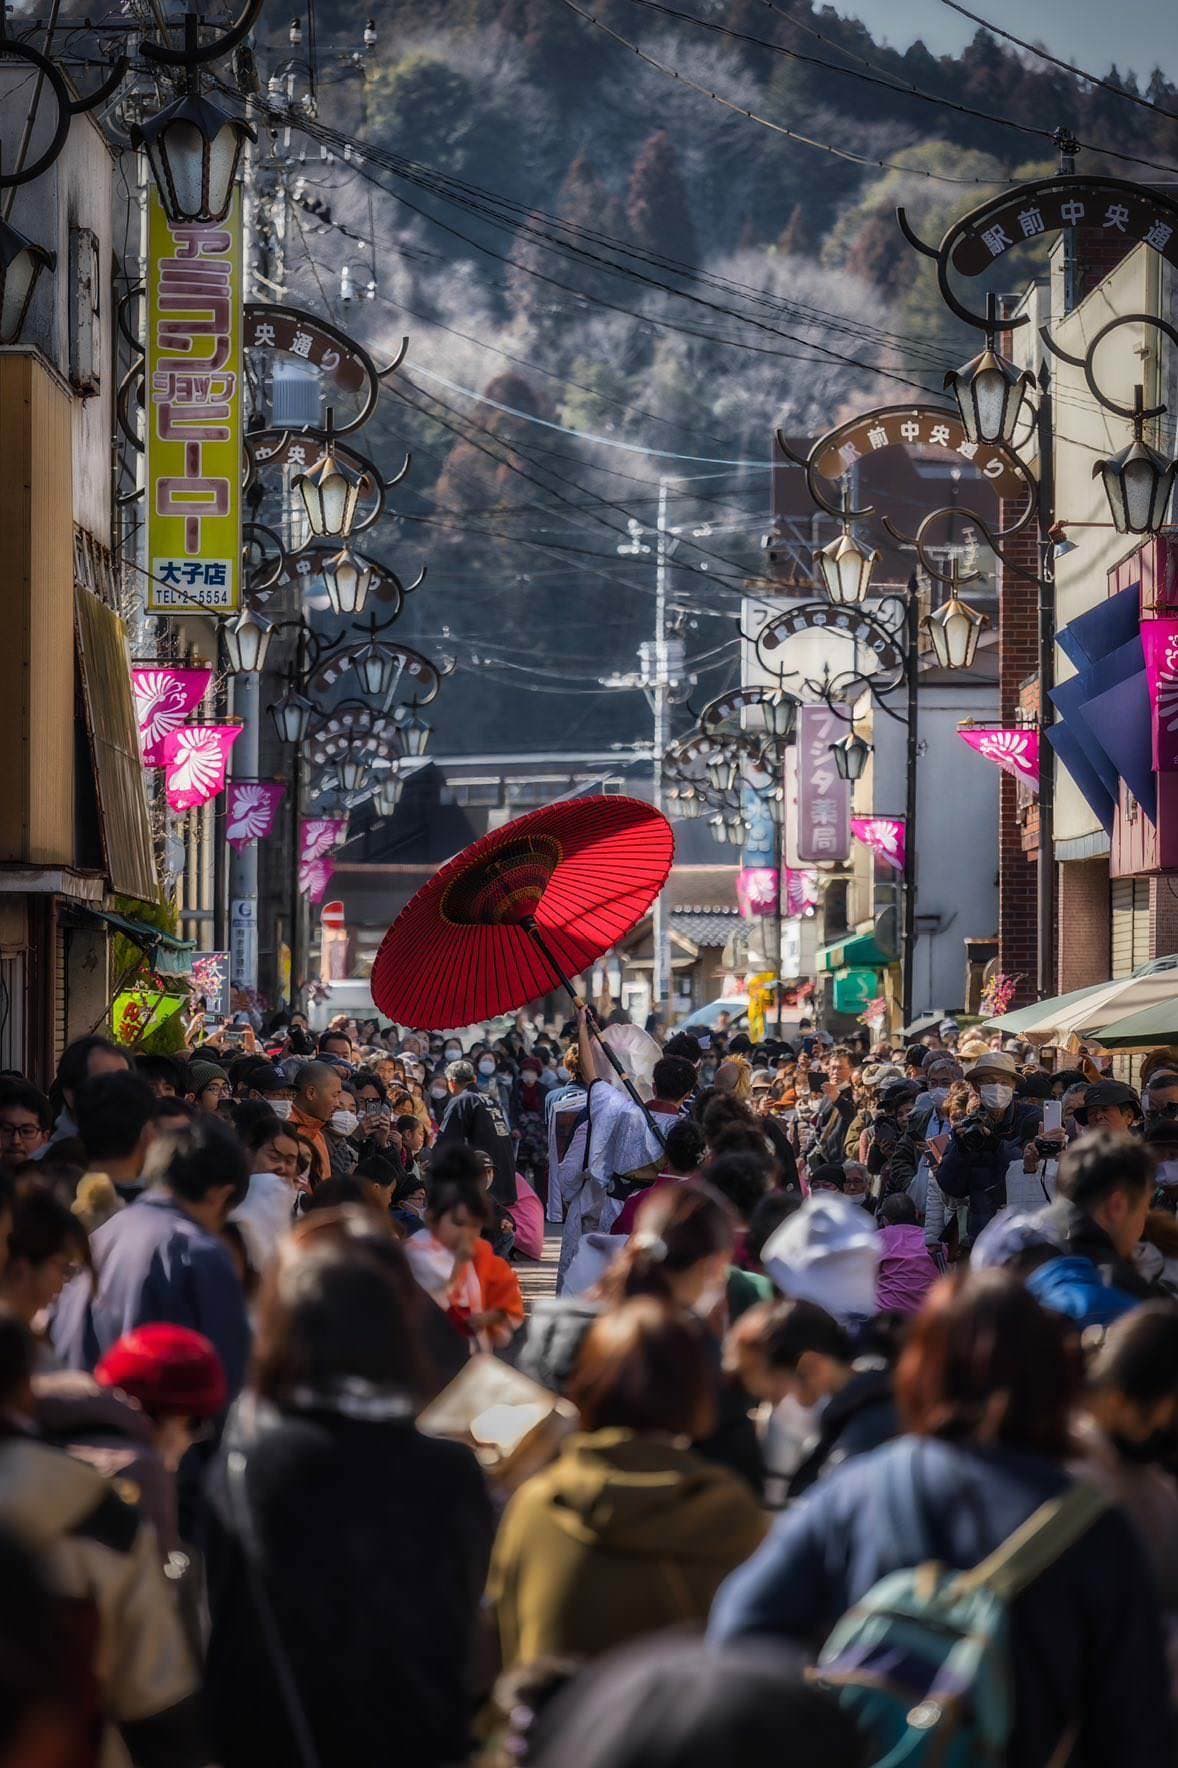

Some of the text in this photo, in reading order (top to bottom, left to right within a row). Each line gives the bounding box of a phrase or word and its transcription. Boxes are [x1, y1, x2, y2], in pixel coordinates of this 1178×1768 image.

[981, 199, 1174, 256] 駅前中央通
[254, 323, 340, 371] 央通り
[838, 420, 1005, 479] 駅前中央通り
[159, 561, 227, 587] 大子店
